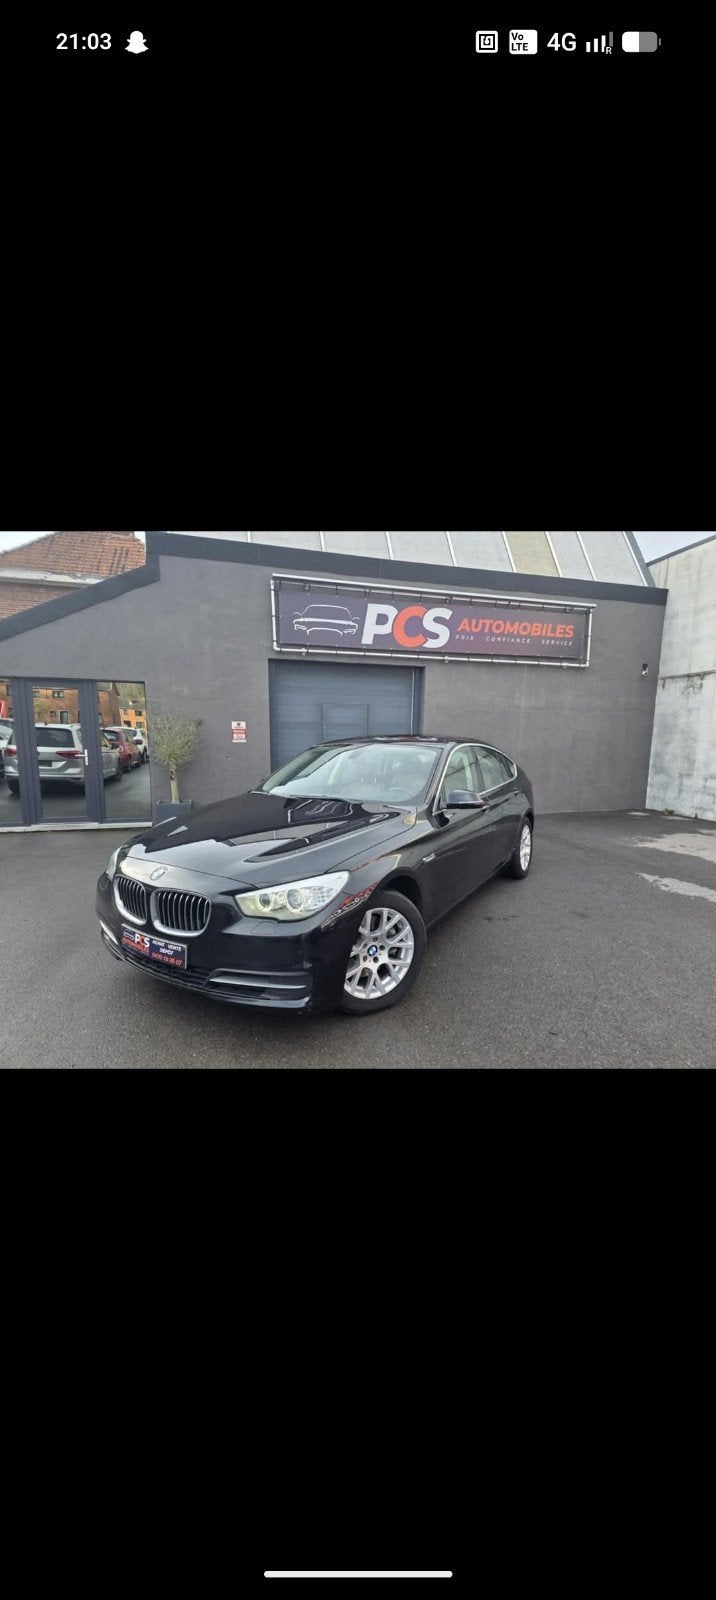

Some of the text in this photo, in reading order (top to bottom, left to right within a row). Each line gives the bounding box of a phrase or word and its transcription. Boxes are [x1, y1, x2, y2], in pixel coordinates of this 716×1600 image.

[361, 603, 575, 648] PCS AUTOMOBILES
[485, 636, 531, 644] CONFIANCE
[134, 933, 150, 947] PCS
